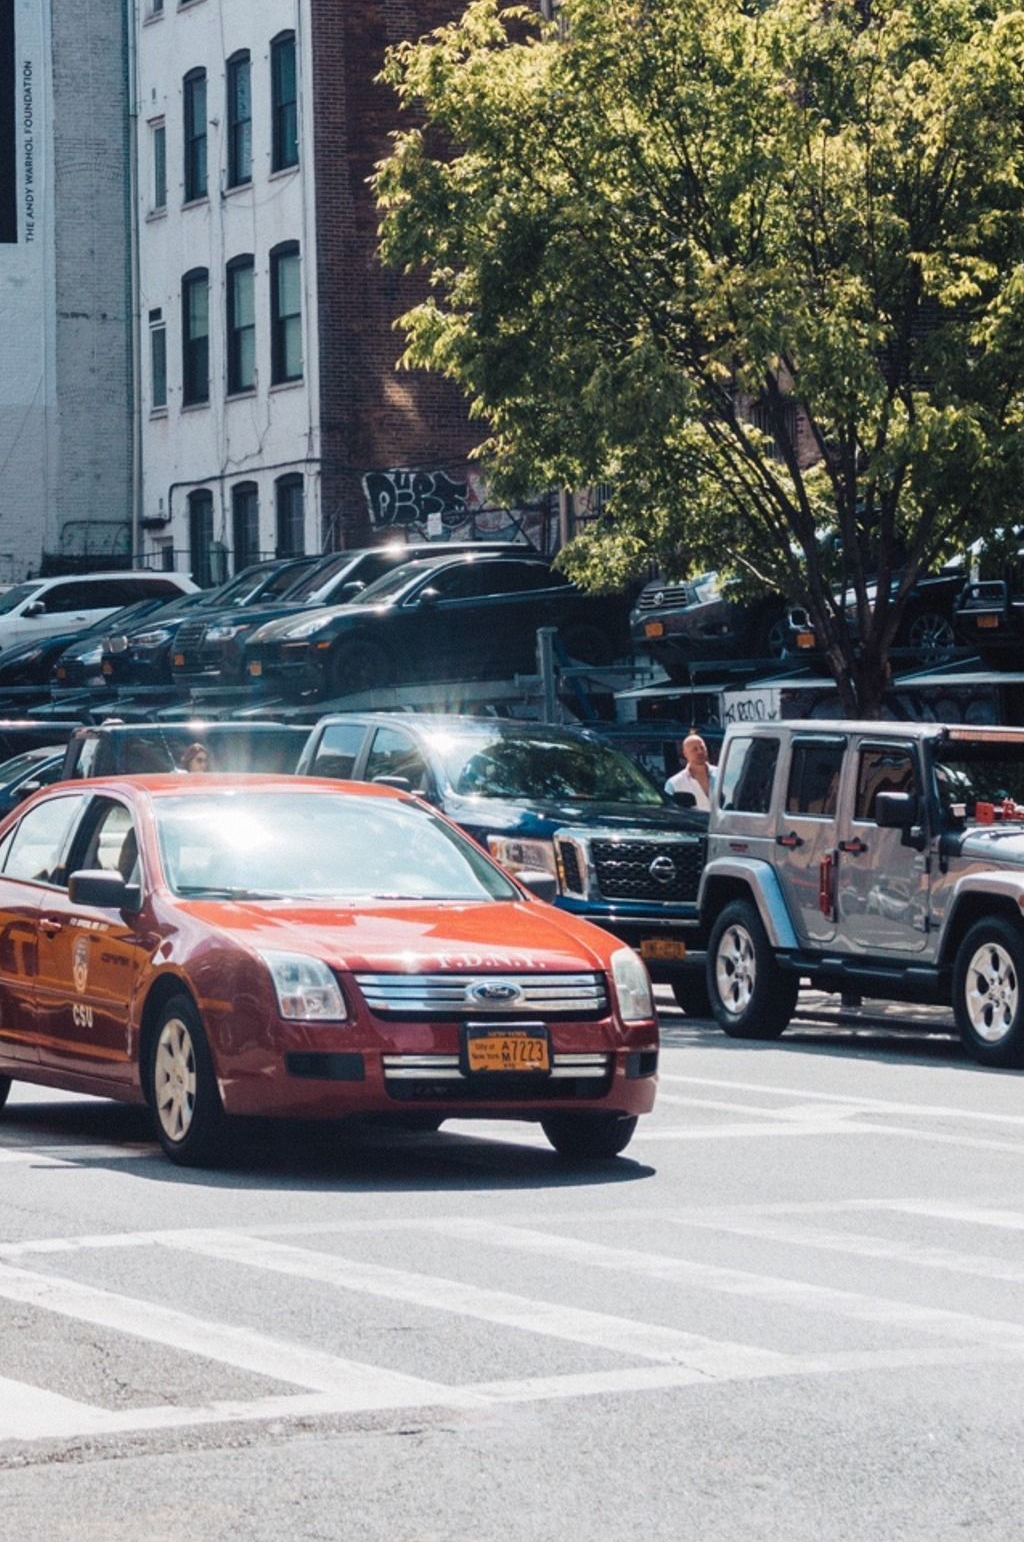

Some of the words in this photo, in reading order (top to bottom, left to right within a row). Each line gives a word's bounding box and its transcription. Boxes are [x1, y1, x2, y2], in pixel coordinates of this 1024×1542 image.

[23, 60, 33, 135] FOUNDATION
[24, 136, 34, 186] WARHOL
[25, 187, 35, 219] ANDY
[25, 221, 35, 243] THE
